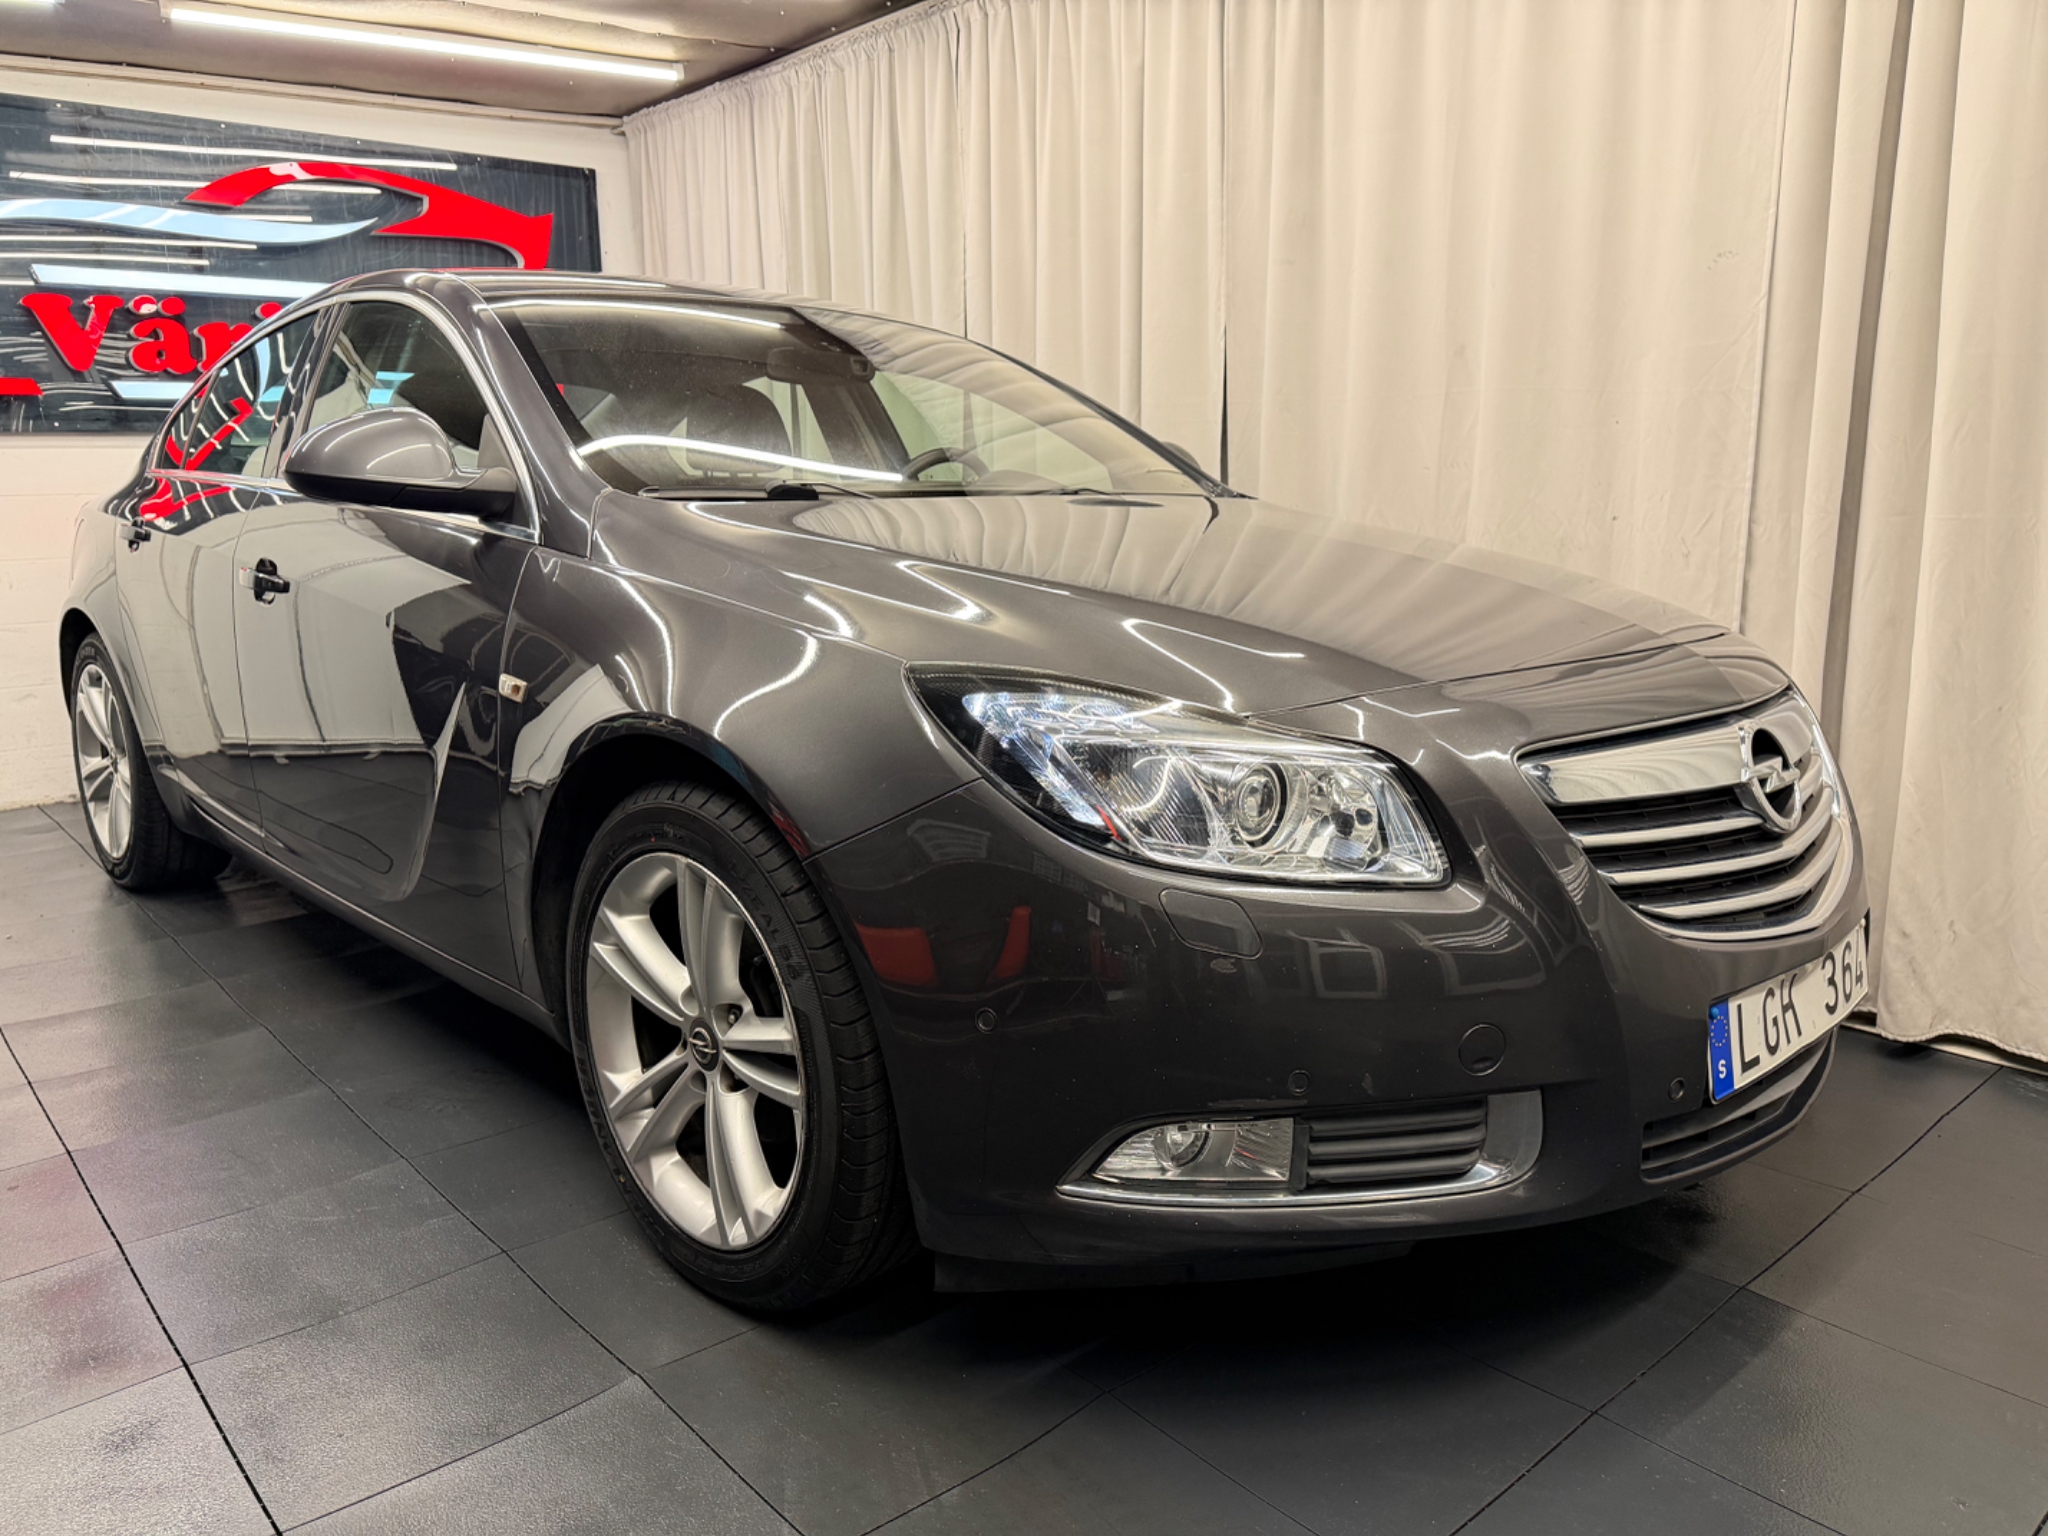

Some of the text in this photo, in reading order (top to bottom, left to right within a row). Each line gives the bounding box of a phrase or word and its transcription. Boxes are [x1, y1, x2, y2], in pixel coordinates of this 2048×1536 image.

[19, 292, 284, 375] Vär
[1736, 927, 1864, 1076] LGH 364
[1717, 1058, 1727, 1079] S
